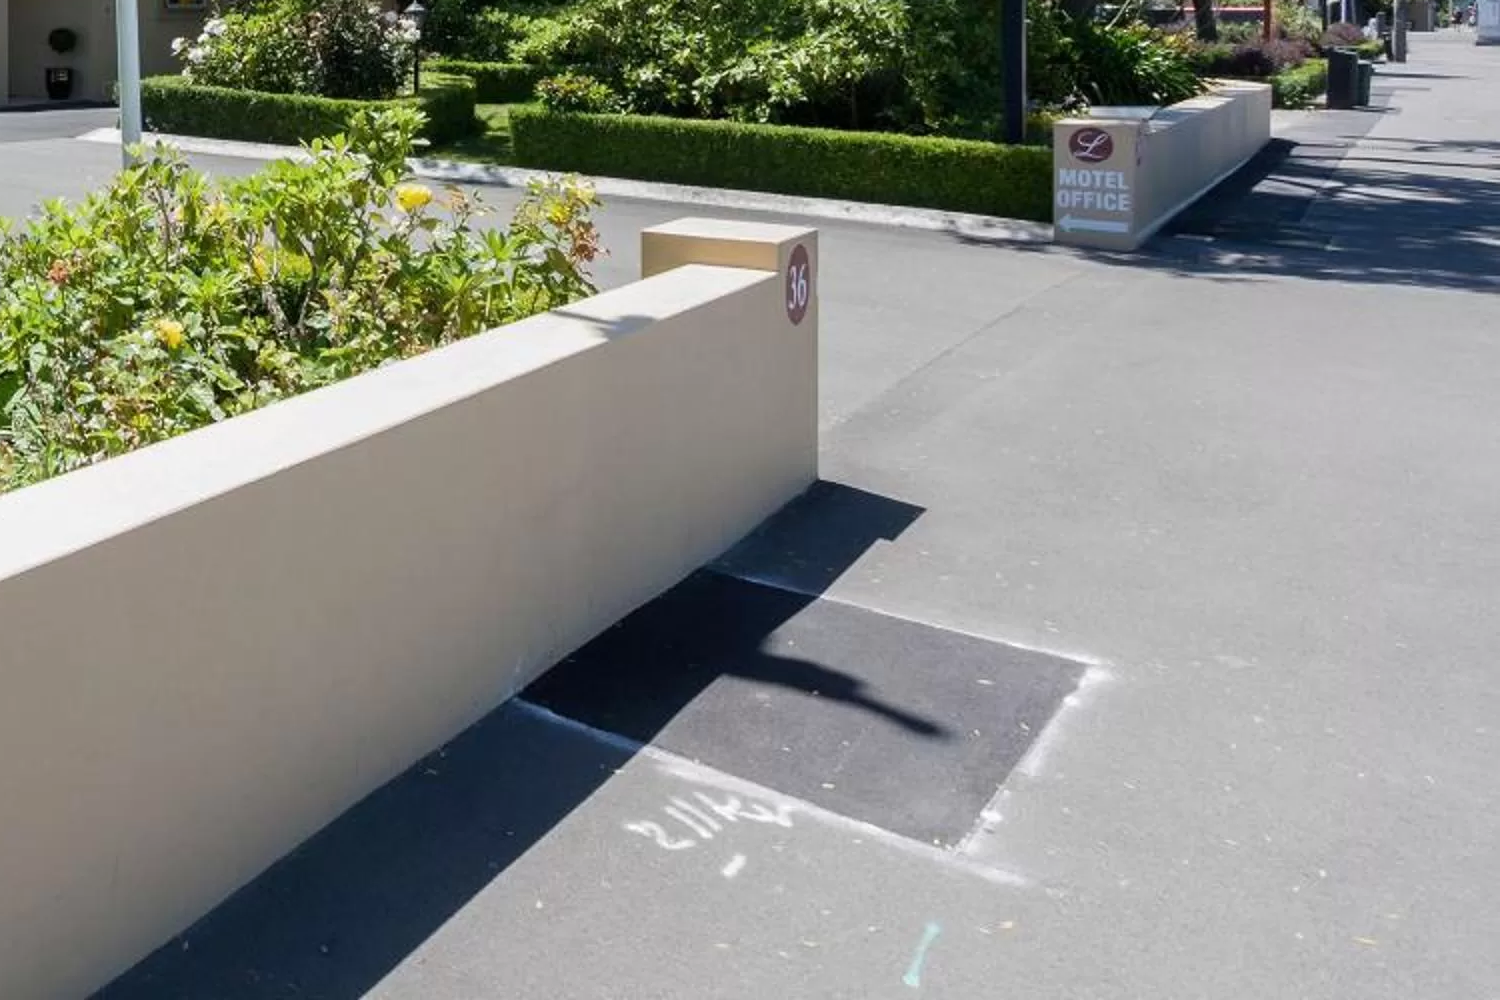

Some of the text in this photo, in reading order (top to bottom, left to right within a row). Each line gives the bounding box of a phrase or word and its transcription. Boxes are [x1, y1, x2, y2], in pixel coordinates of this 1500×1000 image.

[1059, 168, 1131, 190] MOTEL
[1057, 190, 1132, 211] OFFICE
[788, 263, 807, 310] 36
